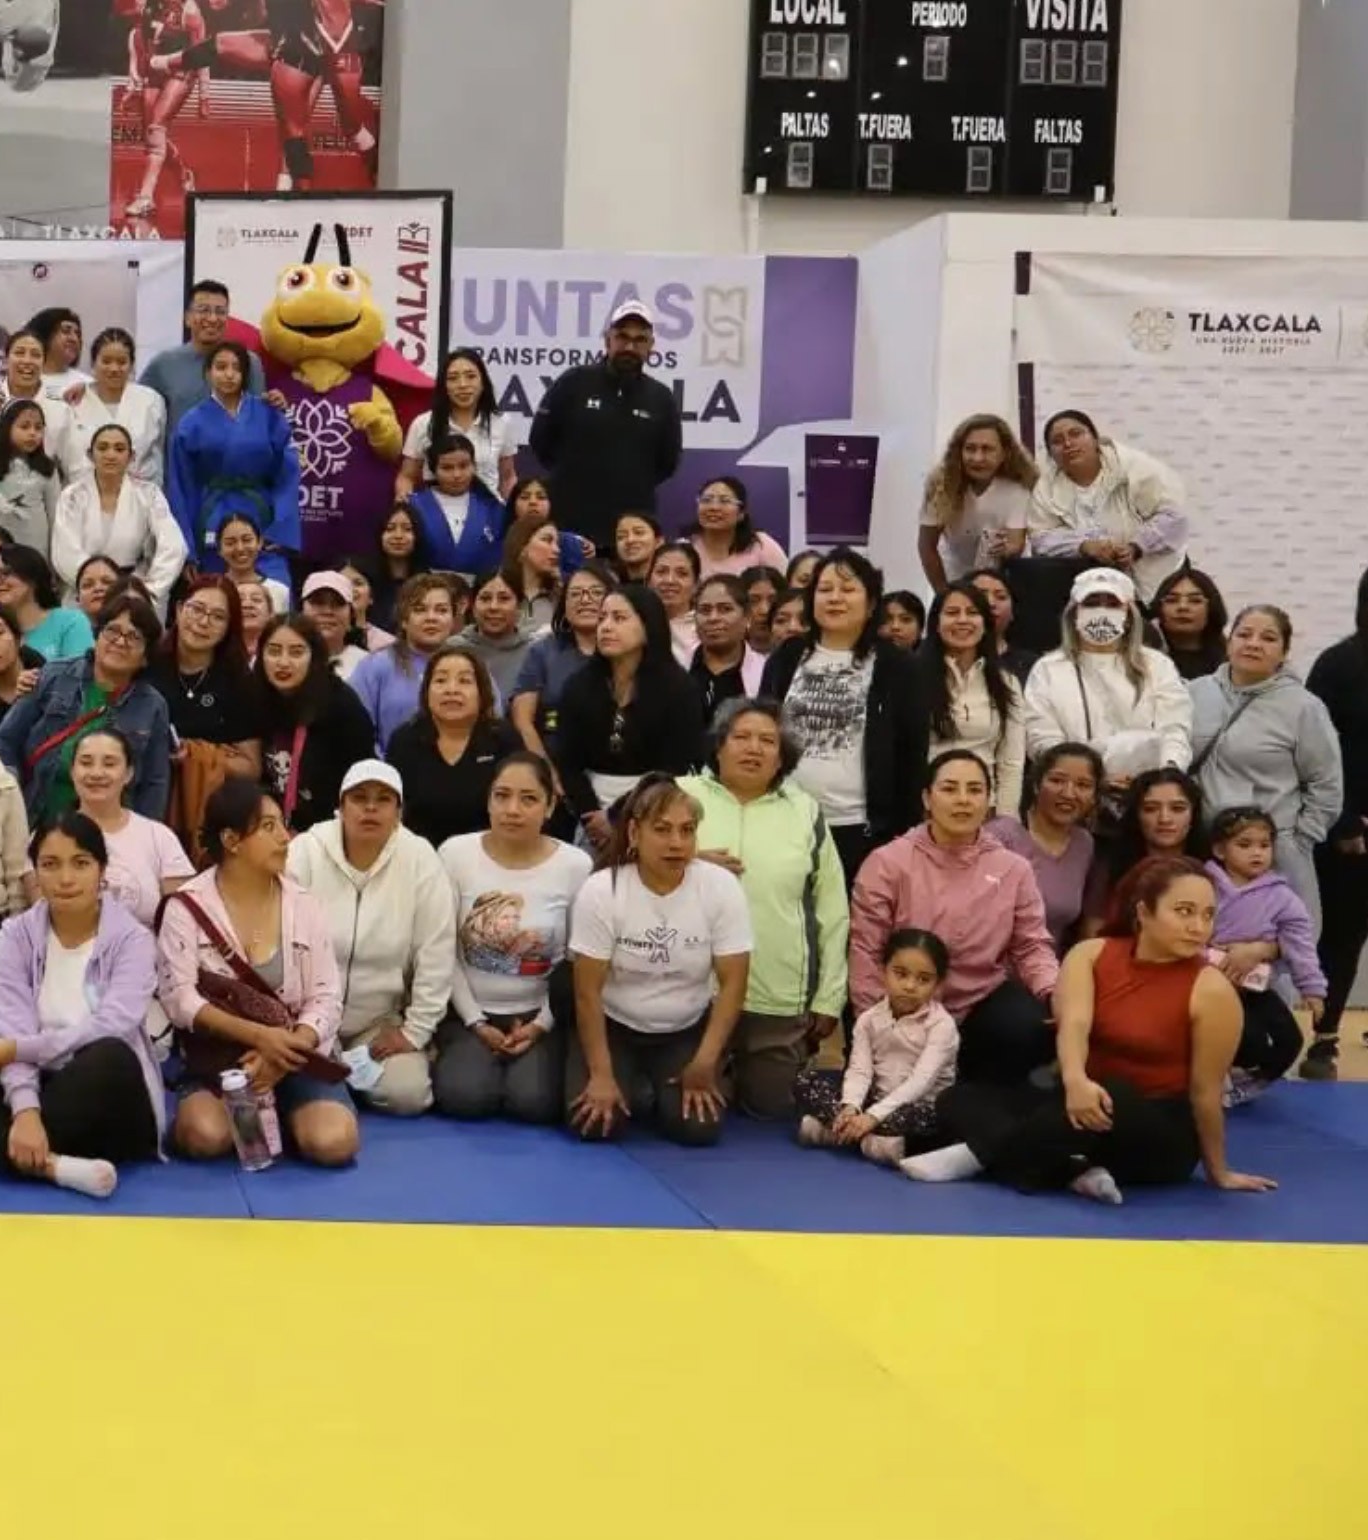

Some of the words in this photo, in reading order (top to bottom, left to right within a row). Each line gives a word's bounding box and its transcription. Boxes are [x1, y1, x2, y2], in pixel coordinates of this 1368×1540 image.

[911, 2, 967, 27] PERIODO
[1026, 0, 1108, 32] VISITA
[858, 114, 912, 140] T.FUERA
[951, 116, 1005, 142] T.FUERA
[1034, 119, 1082, 143] FALTAS
[241, 229, 299, 238] TLAXCALA
[396, 260, 429, 367] CALA
[461, 277, 695, 341] UNTAS
[1188, 312, 1322, 333] TLAXCALA
[298, 485, 344, 509] DET
